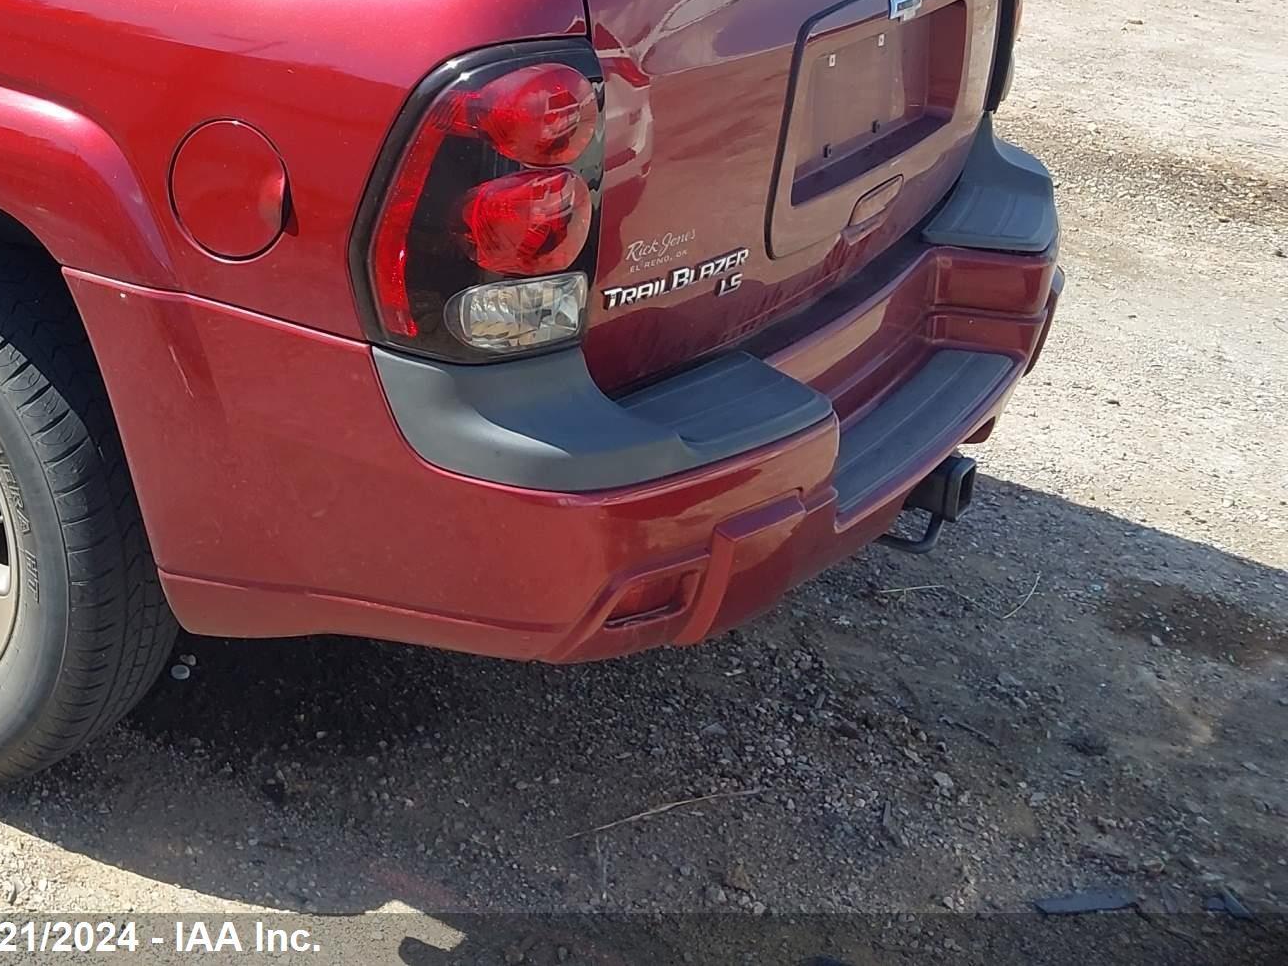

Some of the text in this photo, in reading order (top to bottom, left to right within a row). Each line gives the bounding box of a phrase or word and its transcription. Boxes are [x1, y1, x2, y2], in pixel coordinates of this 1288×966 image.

[625, 228, 696, 262] Rick Jones
[629, 264, 641, 274] EL
[716, 272, 743, 298] LS
